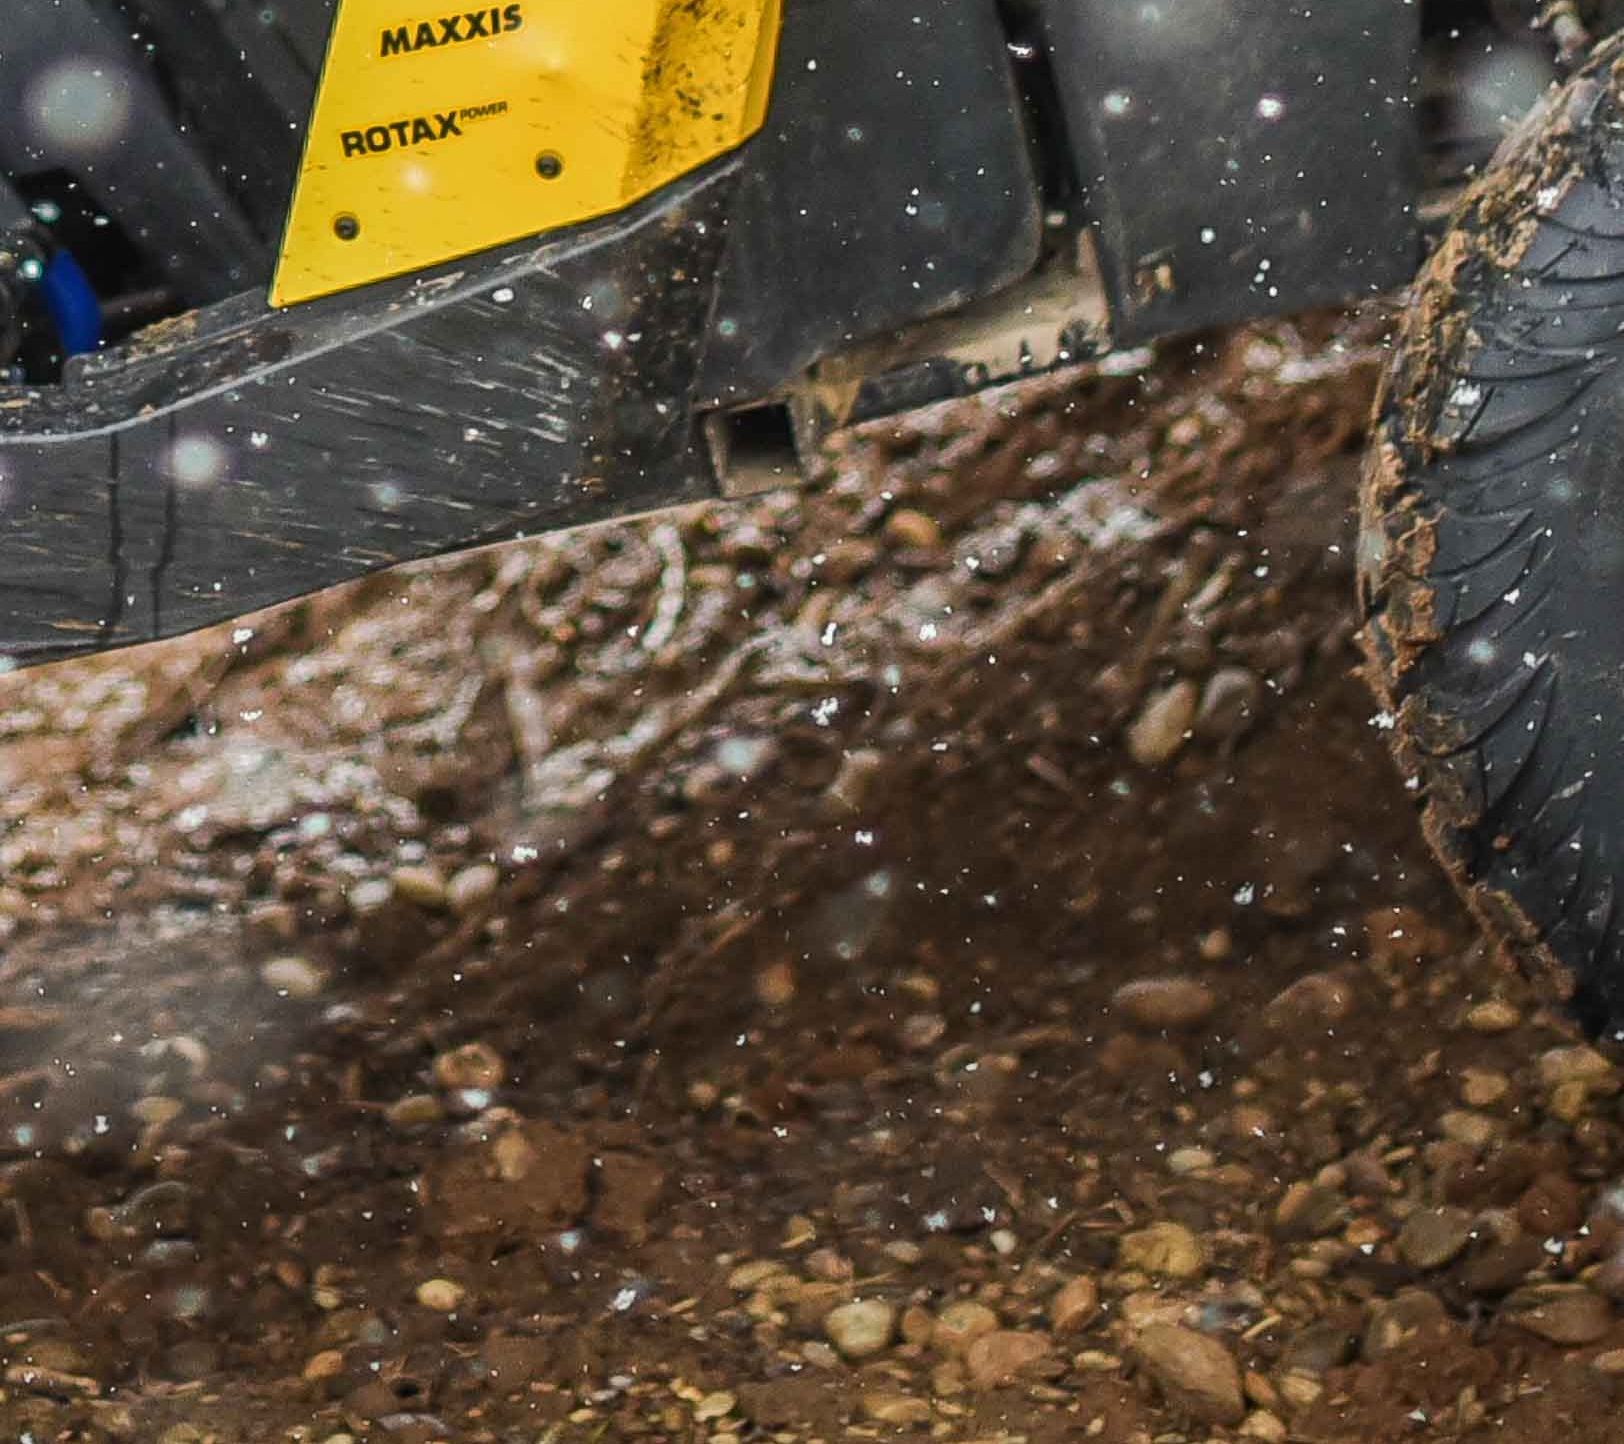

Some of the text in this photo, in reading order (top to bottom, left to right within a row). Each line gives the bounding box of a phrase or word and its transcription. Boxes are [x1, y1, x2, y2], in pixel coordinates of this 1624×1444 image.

[379, 3, 523, 58] MAXXIS
[340, 100, 508, 158] ROTAX POWER
